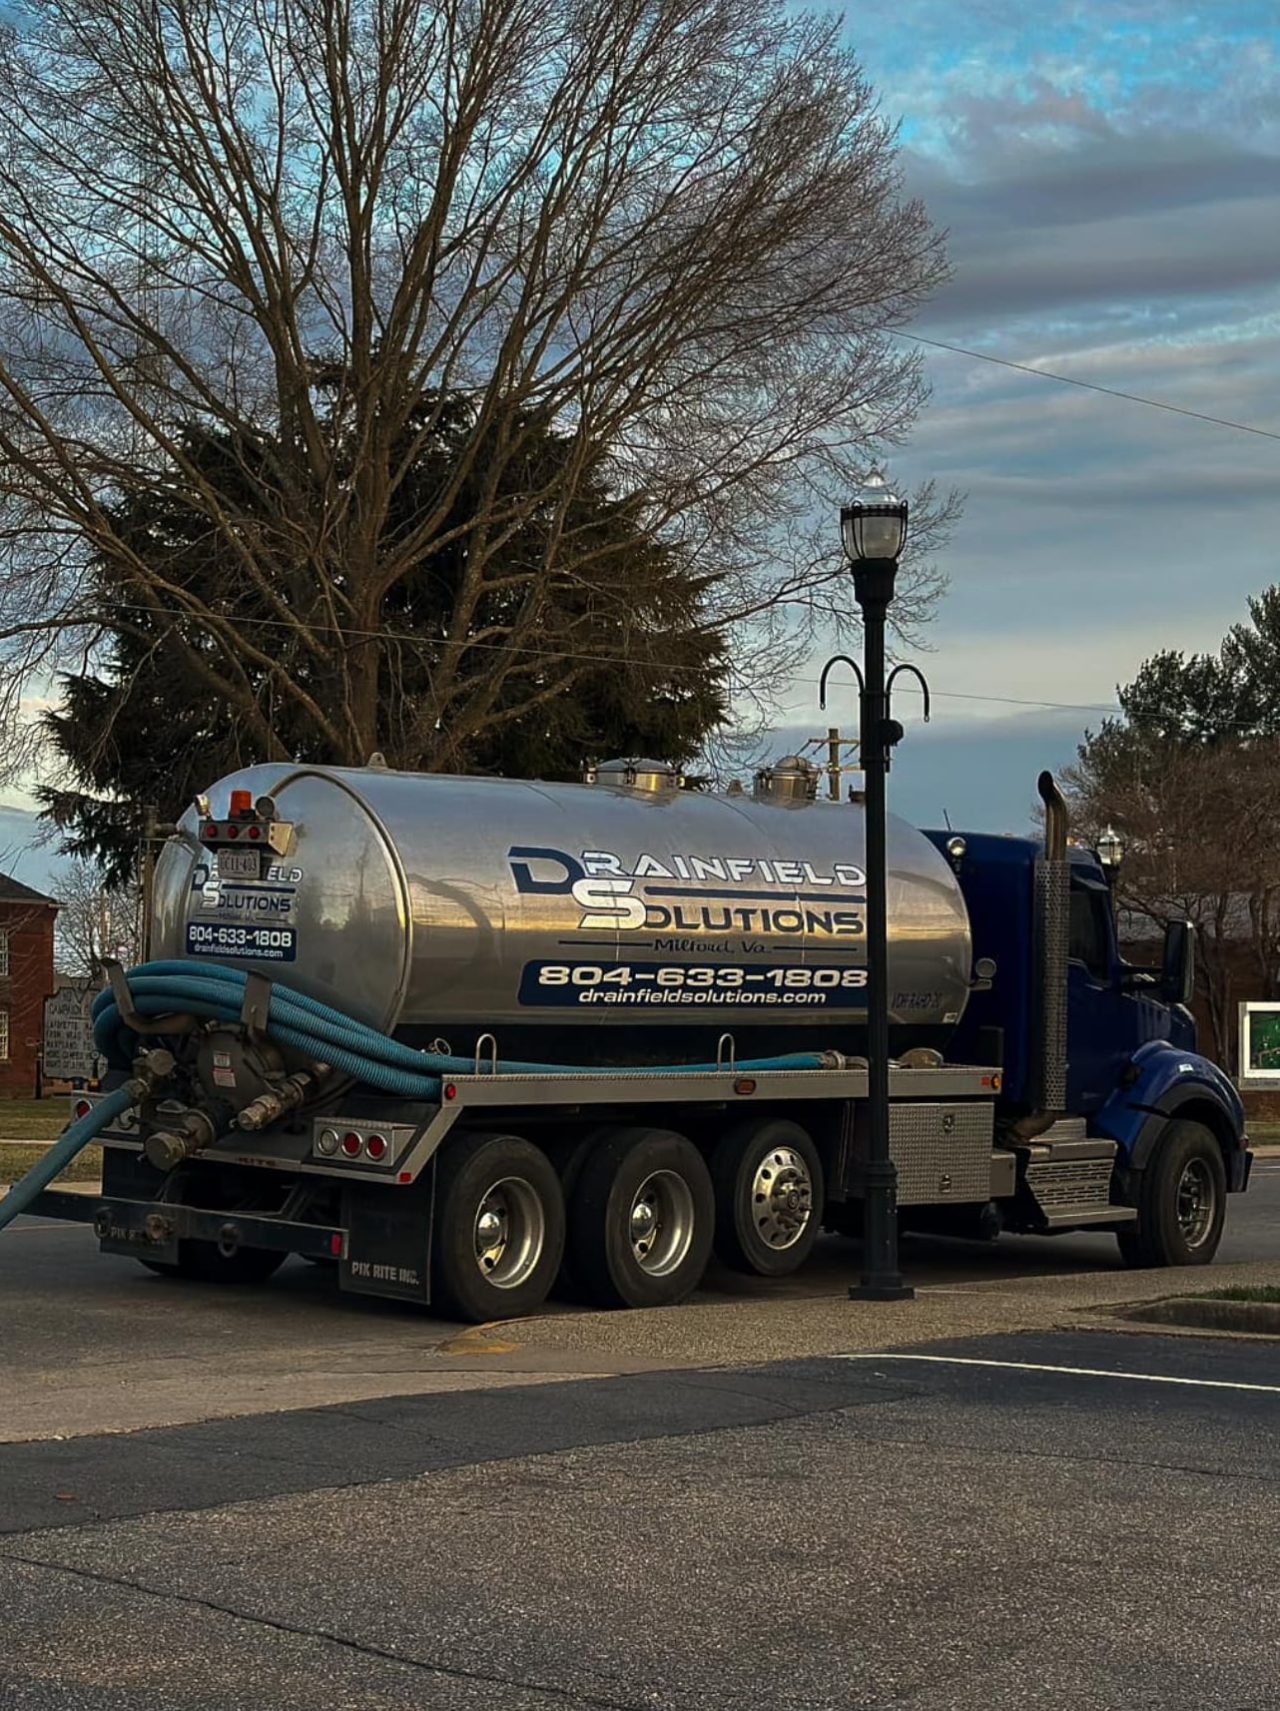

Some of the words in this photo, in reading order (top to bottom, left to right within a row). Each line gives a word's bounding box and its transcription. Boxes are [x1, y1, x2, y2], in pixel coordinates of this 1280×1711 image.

[507, 846, 866, 894] DRAINFIELD
[201, 880, 291, 912] SOLUTIONS
[572, 878, 864, 935] SOLUTIONS
[188, 926, 292, 948] 804-633-1808
[538, 966, 869, 988] 804-633-1808
[579, 988, 826, 1004] drainfieldsolutions.com
[373, 1264, 397, 1281] RITE
